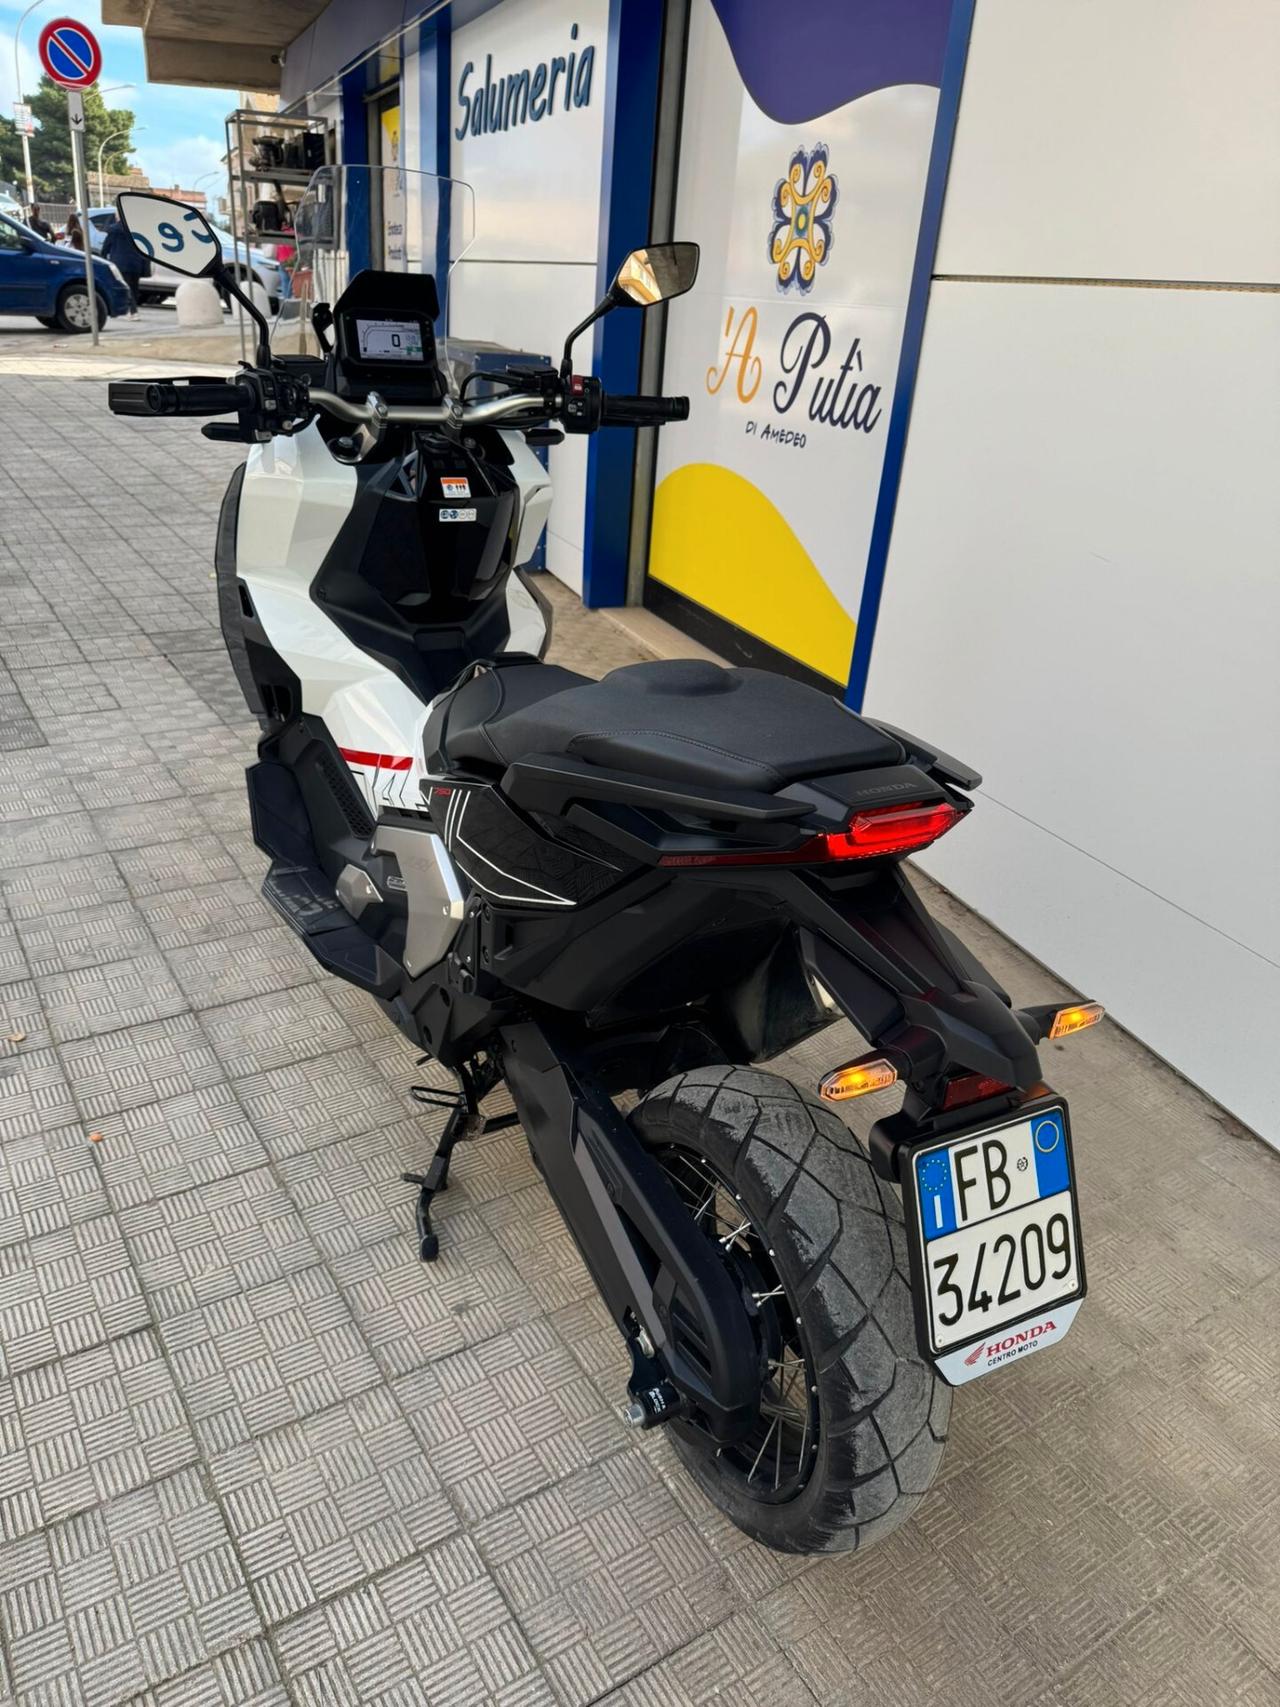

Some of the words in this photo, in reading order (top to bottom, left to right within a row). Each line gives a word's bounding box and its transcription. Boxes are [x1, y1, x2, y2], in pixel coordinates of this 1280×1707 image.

[454, 22, 595, 141] Salumeria
[391, 333, 401, 348] 0
[773, 311, 882, 434] Putìa
[745, 420, 758, 436] DI
[760, 423, 807, 449] AMEDEO
[855, 782, 919, 797] HONDA
[953, 1138, 1012, 1222] FB
[933, 1212, 1072, 1327] 34209
[986, 1320, 1057, 1357] HONDA
[987, 1349, 1017, 1367] CENTRO
[1017, 1339, 1039, 1354] MOTO
